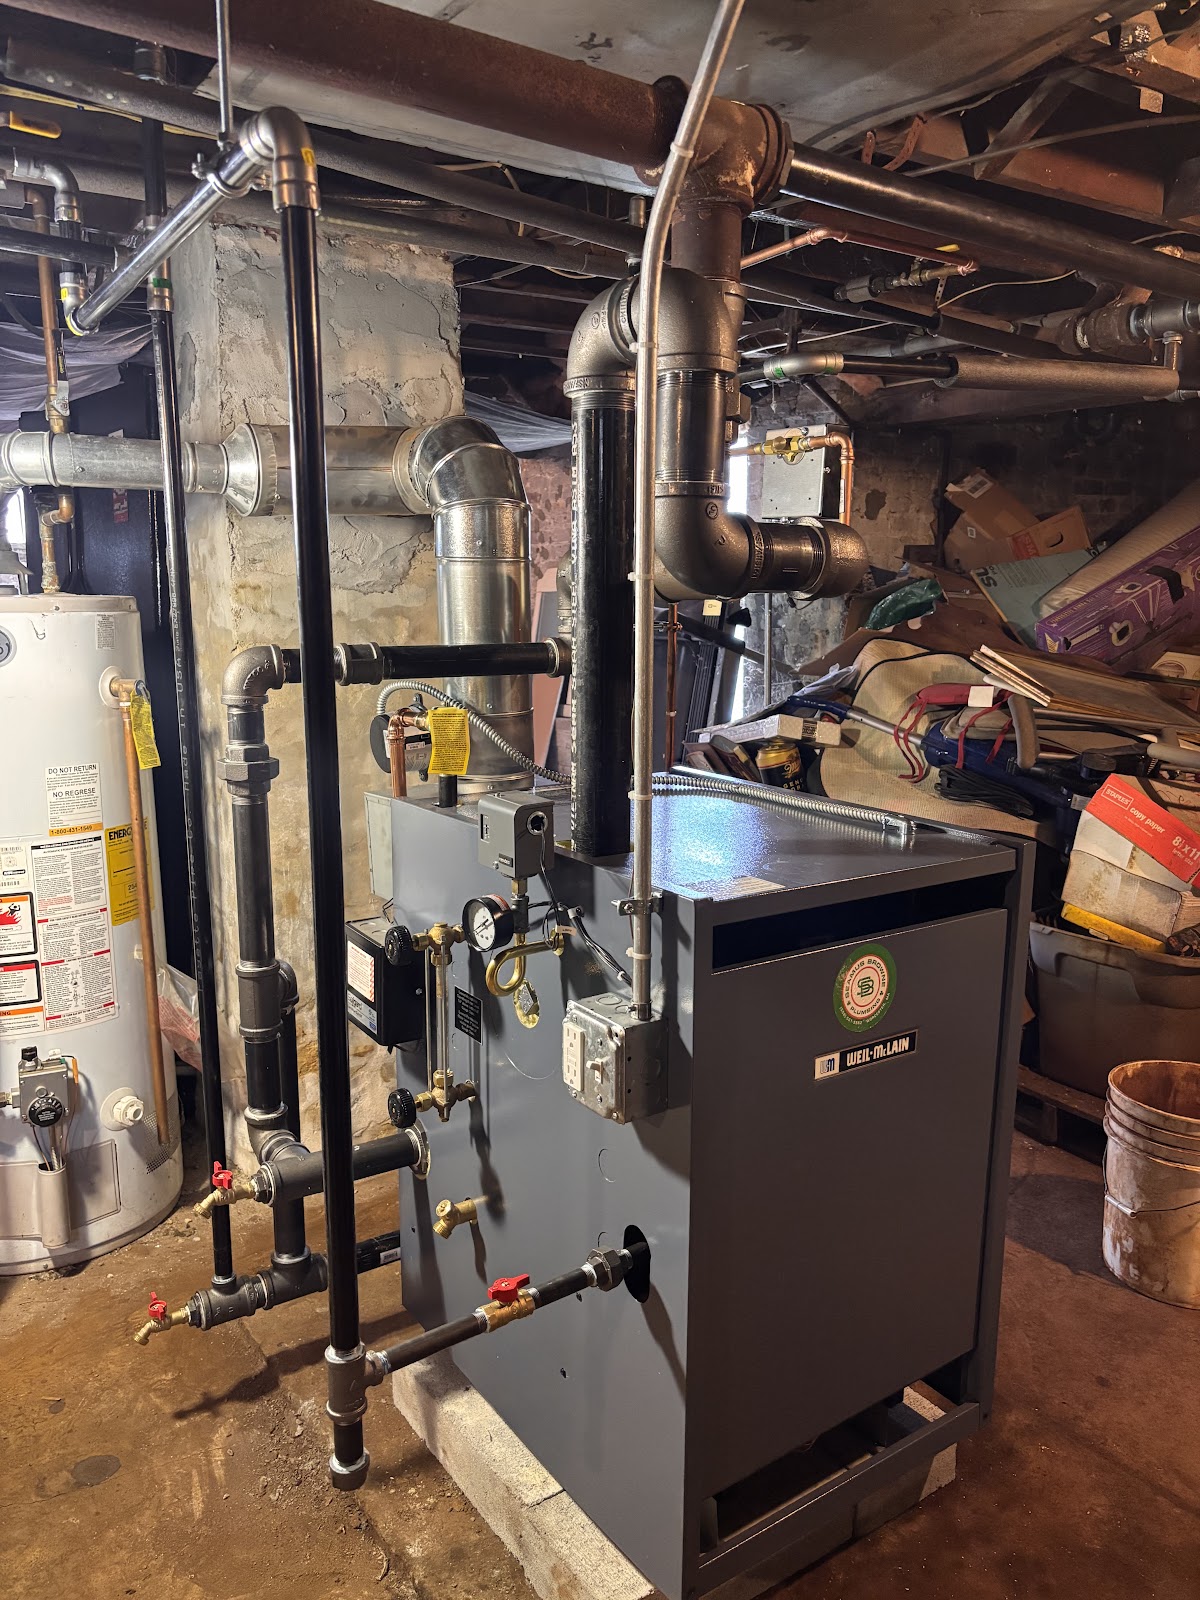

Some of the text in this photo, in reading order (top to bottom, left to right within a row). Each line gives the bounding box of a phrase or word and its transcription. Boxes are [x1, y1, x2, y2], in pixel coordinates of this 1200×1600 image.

[175, 657, 184, 693] USA
[48, 764, 97, 775] DO NOT RETURN
[182, 744, 190, 791] Made
[65, 787, 96, 797] REGRESE
[570, 762, 578, 831] VIETNAM
[1105, 788, 1131, 805] STAPLES
[1129, 807, 1147, 821] copy
[1144, 818, 1166, 834] paper
[844, 958, 886, 998] SEAMUS BROWNE
[850, 998, 881, 1015] PLUMBING
